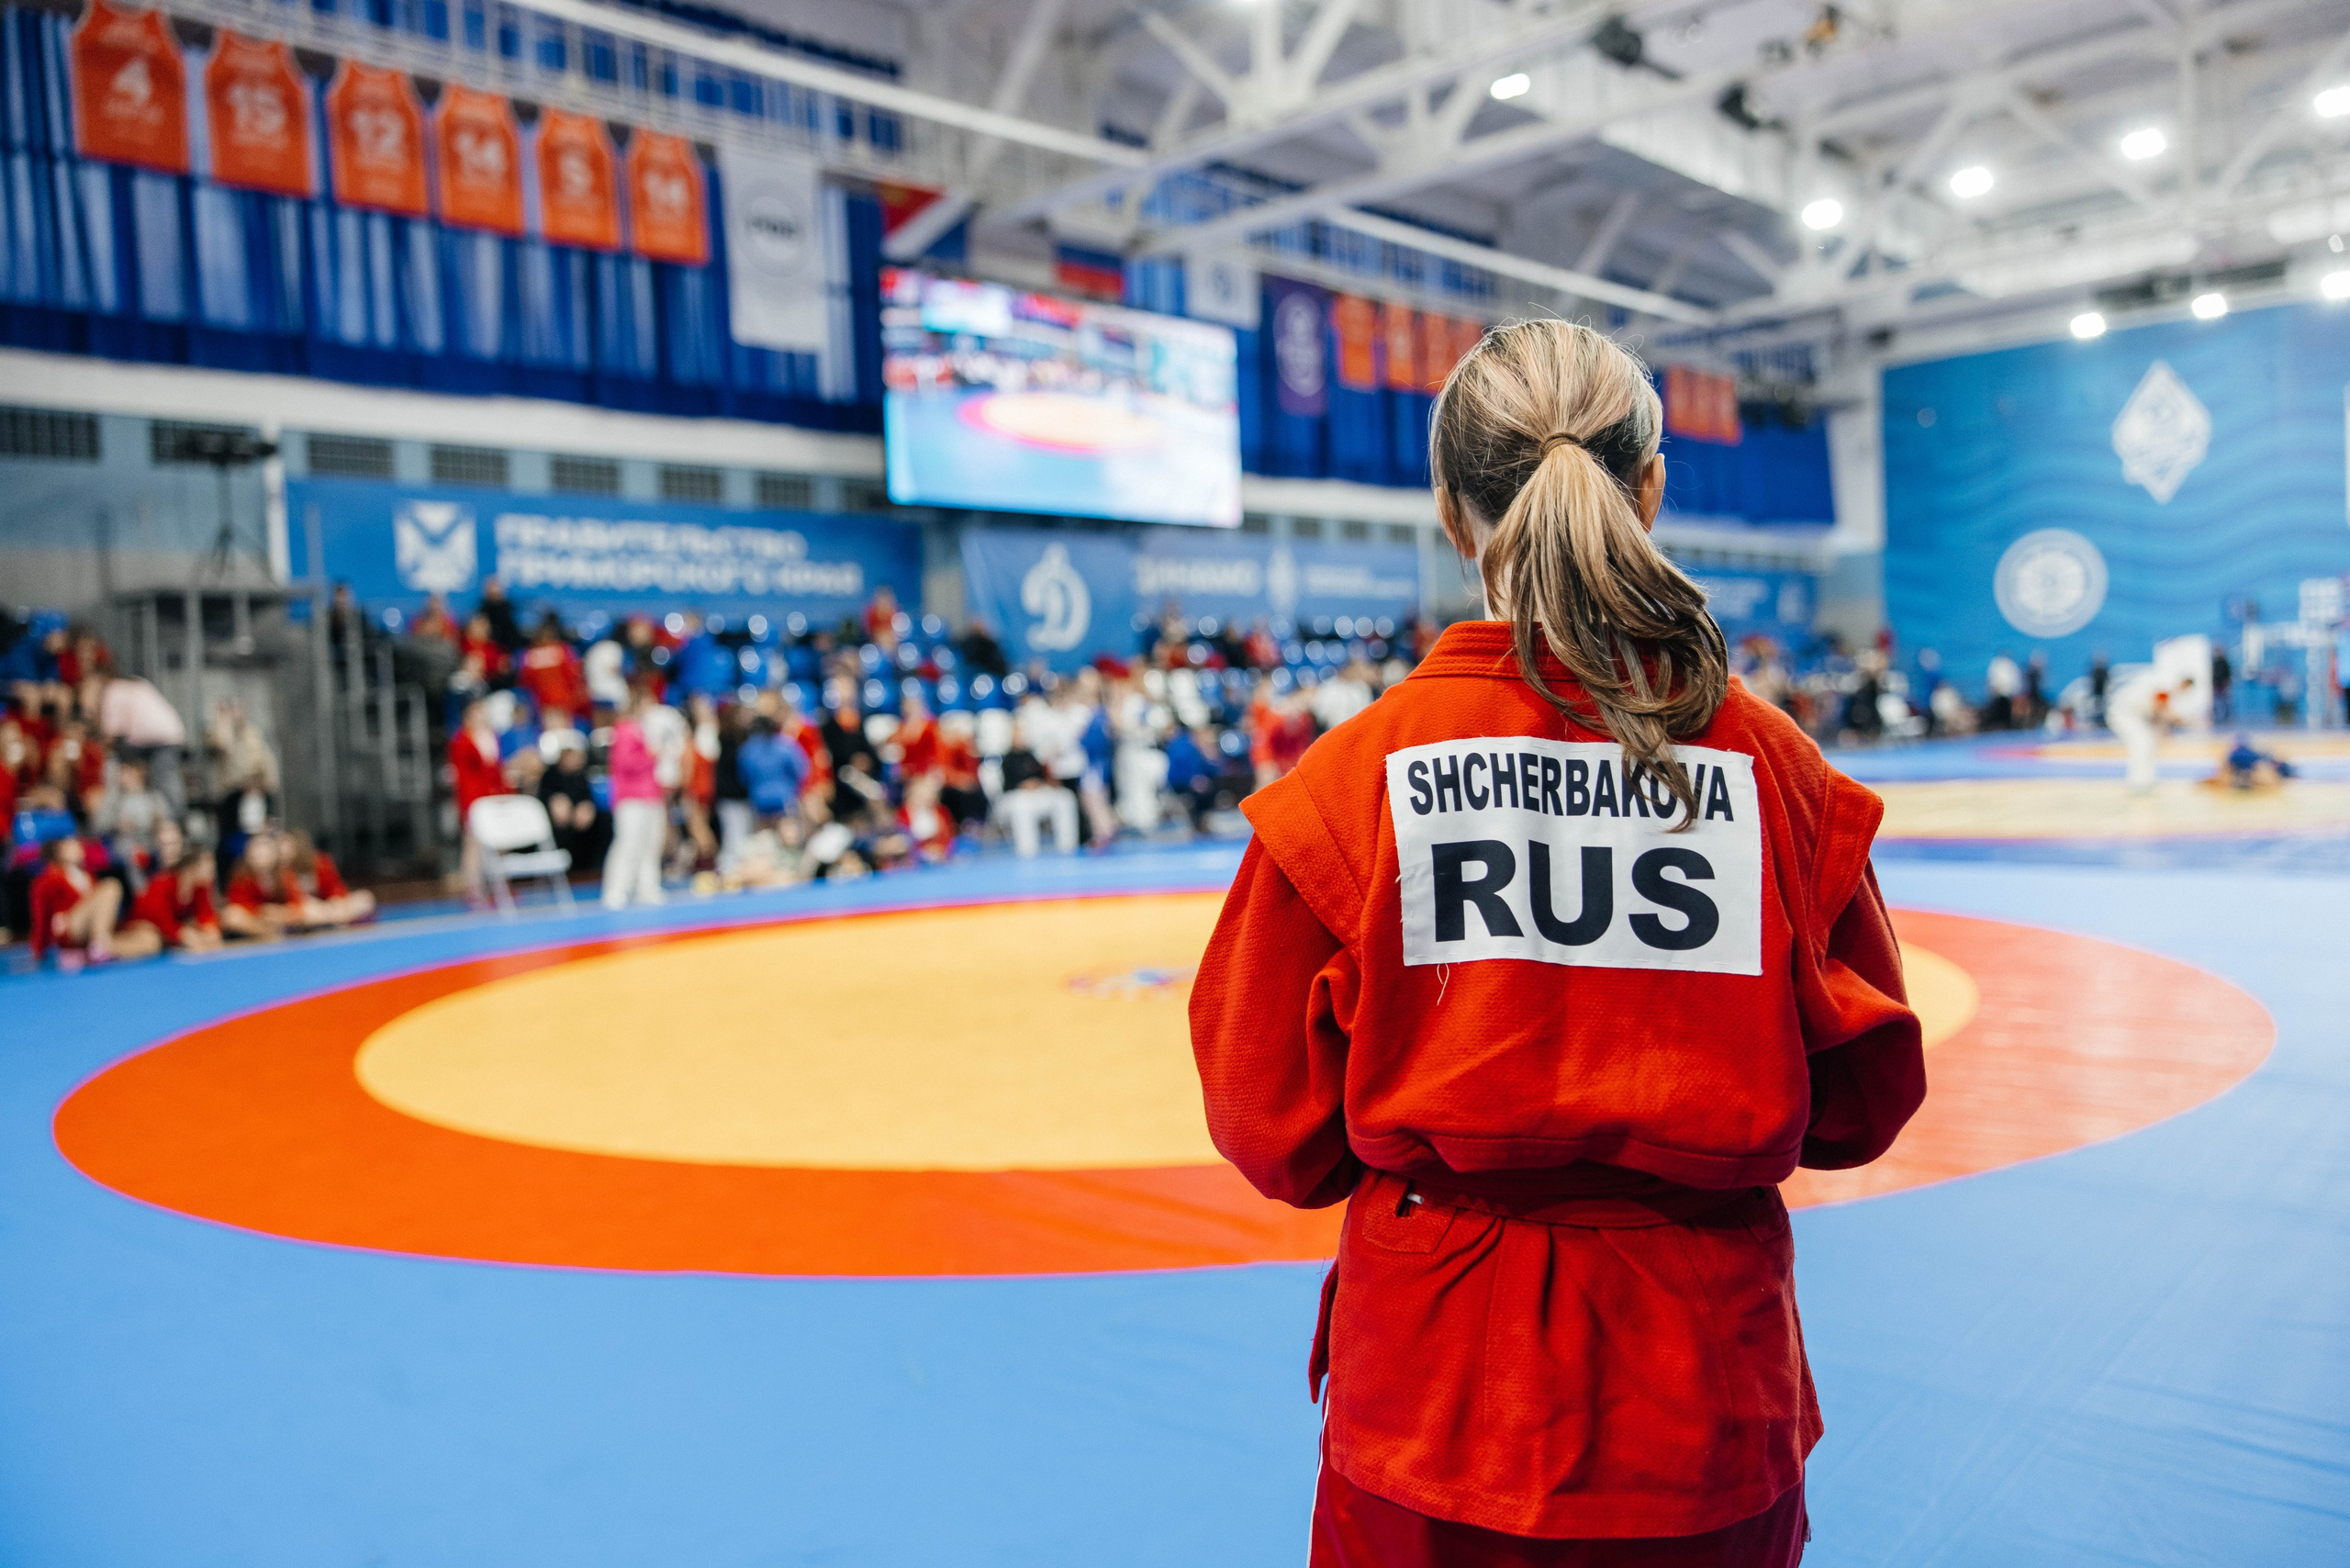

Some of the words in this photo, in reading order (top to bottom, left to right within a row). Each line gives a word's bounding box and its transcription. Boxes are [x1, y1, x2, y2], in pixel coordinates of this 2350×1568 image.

[111, 55, 155, 108] 4
[350, 106, 406, 162] 12
[1430, 839, 1719, 950] RUS
